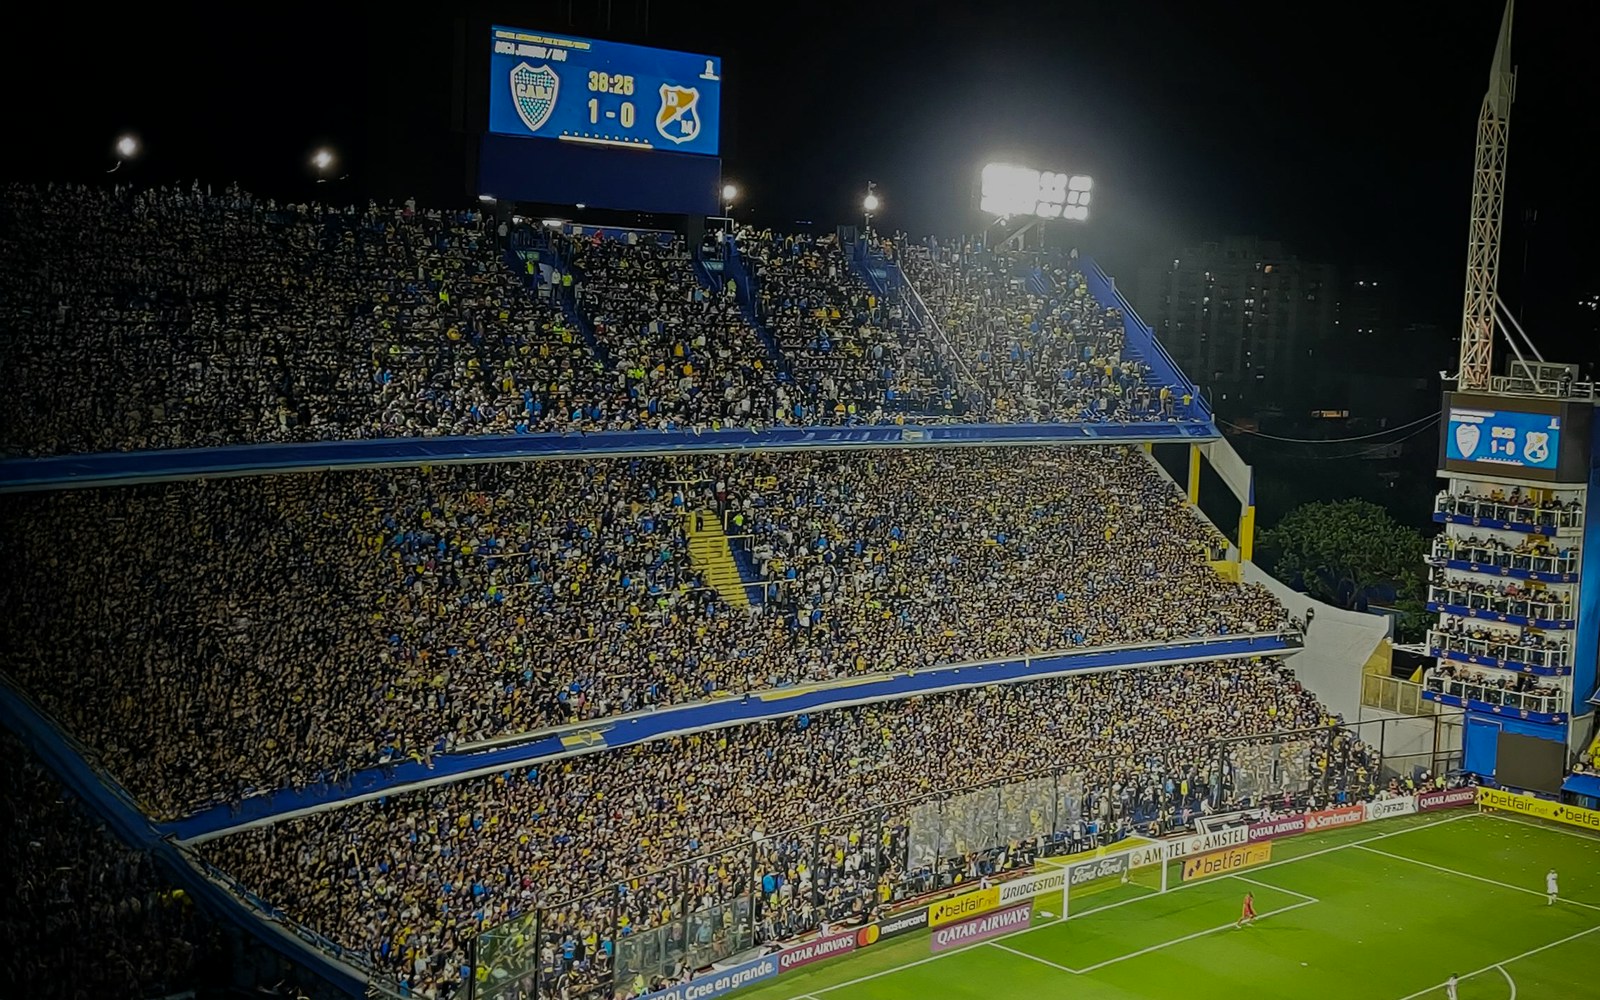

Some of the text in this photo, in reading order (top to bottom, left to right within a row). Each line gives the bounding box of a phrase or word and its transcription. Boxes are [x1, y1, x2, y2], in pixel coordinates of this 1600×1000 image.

[588, 98, 598, 124] 1
[620, 102, 635, 128] 0
[1420, 790, 1474, 808] QATAR AIRWAYS
[1249, 819, 1305, 840] QATAR AIRWAYS
[1317, 811, 1362, 827] Santander
[1203, 829, 1246, 850] AMSTEL
[1143, 842, 1187, 864] AMTEL
[1071, 857, 1122, 885] Ford Ford
[1002, 873, 1065, 901] BRIDGESTONE
[881, 912, 927, 935] mastercard
[937, 907, 1031, 945] QATAR AIRWAYS
[780, 935, 854, 967] QATAR AIRWAYS
[685, 982, 713, 1000] Cree
[715, 976, 731, 991] en
[732, 961, 775, 989] grande.
